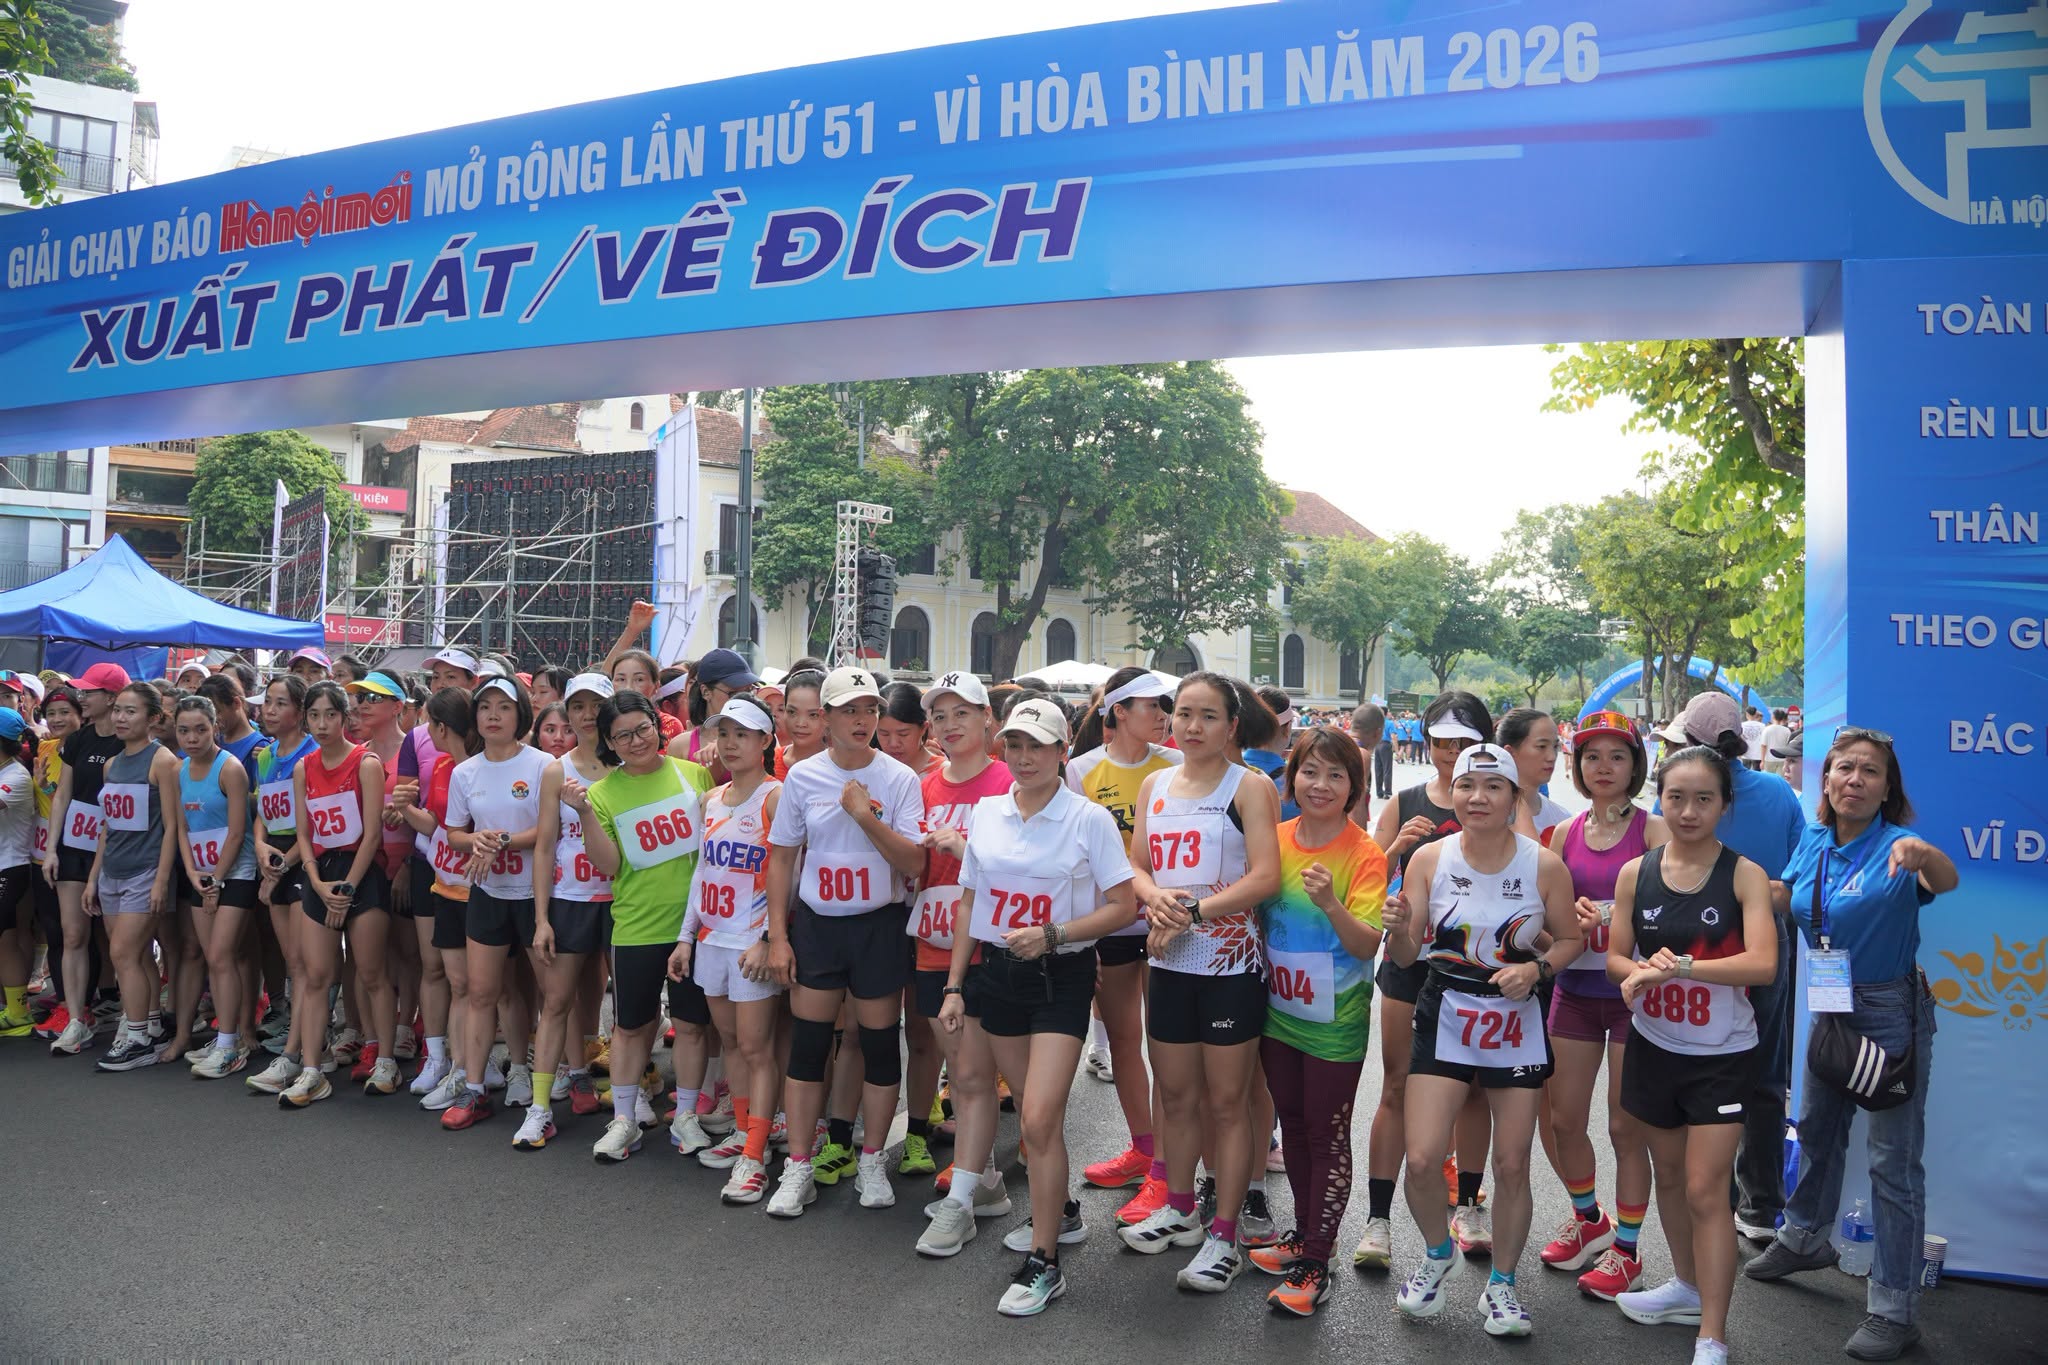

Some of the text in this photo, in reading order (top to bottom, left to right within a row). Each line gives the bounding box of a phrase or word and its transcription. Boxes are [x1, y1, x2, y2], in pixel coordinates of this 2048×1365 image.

[7, 227, 62, 289] GIẢI
[69, 224, 144, 281] CHẠY
[151, 206, 212, 265] BÁO
[423, 145, 486, 217] MỞ
[496, 140, 607, 212] RỘNG
[620, 113, 706, 188] LẦN
[720, 99, 814, 173] THỨ
[822, 101, 876, 159] 51
[934, 74, 982, 145] VÌ
[1000, 62, 1109, 139] HÒA
[1127, 49, 1264, 124] BÌNH
[1285, 28, 1426, 107] NĂM
[1446, 21, 1601, 93] 2026
[1970, 195, 2007, 225] HÀ
[67, 261, 280, 373] XUẤT
[750, 174, 1093, 291] ĐÍCH
[1917, 295, 2031, 335] TOÀN
[1920, 398, 1996, 438] RÈN
[364, 492, 389, 505] KIỆN
[1930, 502, 2039, 544] THÂN
[1890, 613, 2048, 651] THEO G
[851, 674, 866, 686] X
[1950, 713, 2035, 755] BÁC
[103, 793, 135, 820] 630
[261, 791, 291, 821] 885
[312, 805, 347, 837] 25
[635, 808, 693, 852] 866
[1962, 819, 2048, 863] VĨ Đ
[434, 841, 471, 876] 822
[574, 853, 615, 883] 64
[1149, 830, 1202, 872] 673
[818, 866, 871, 902] 801
[990, 888, 1053, 929] 729
[1643, 983, 1711, 1027] 888
[1456, 1008, 1523, 1050] 724
